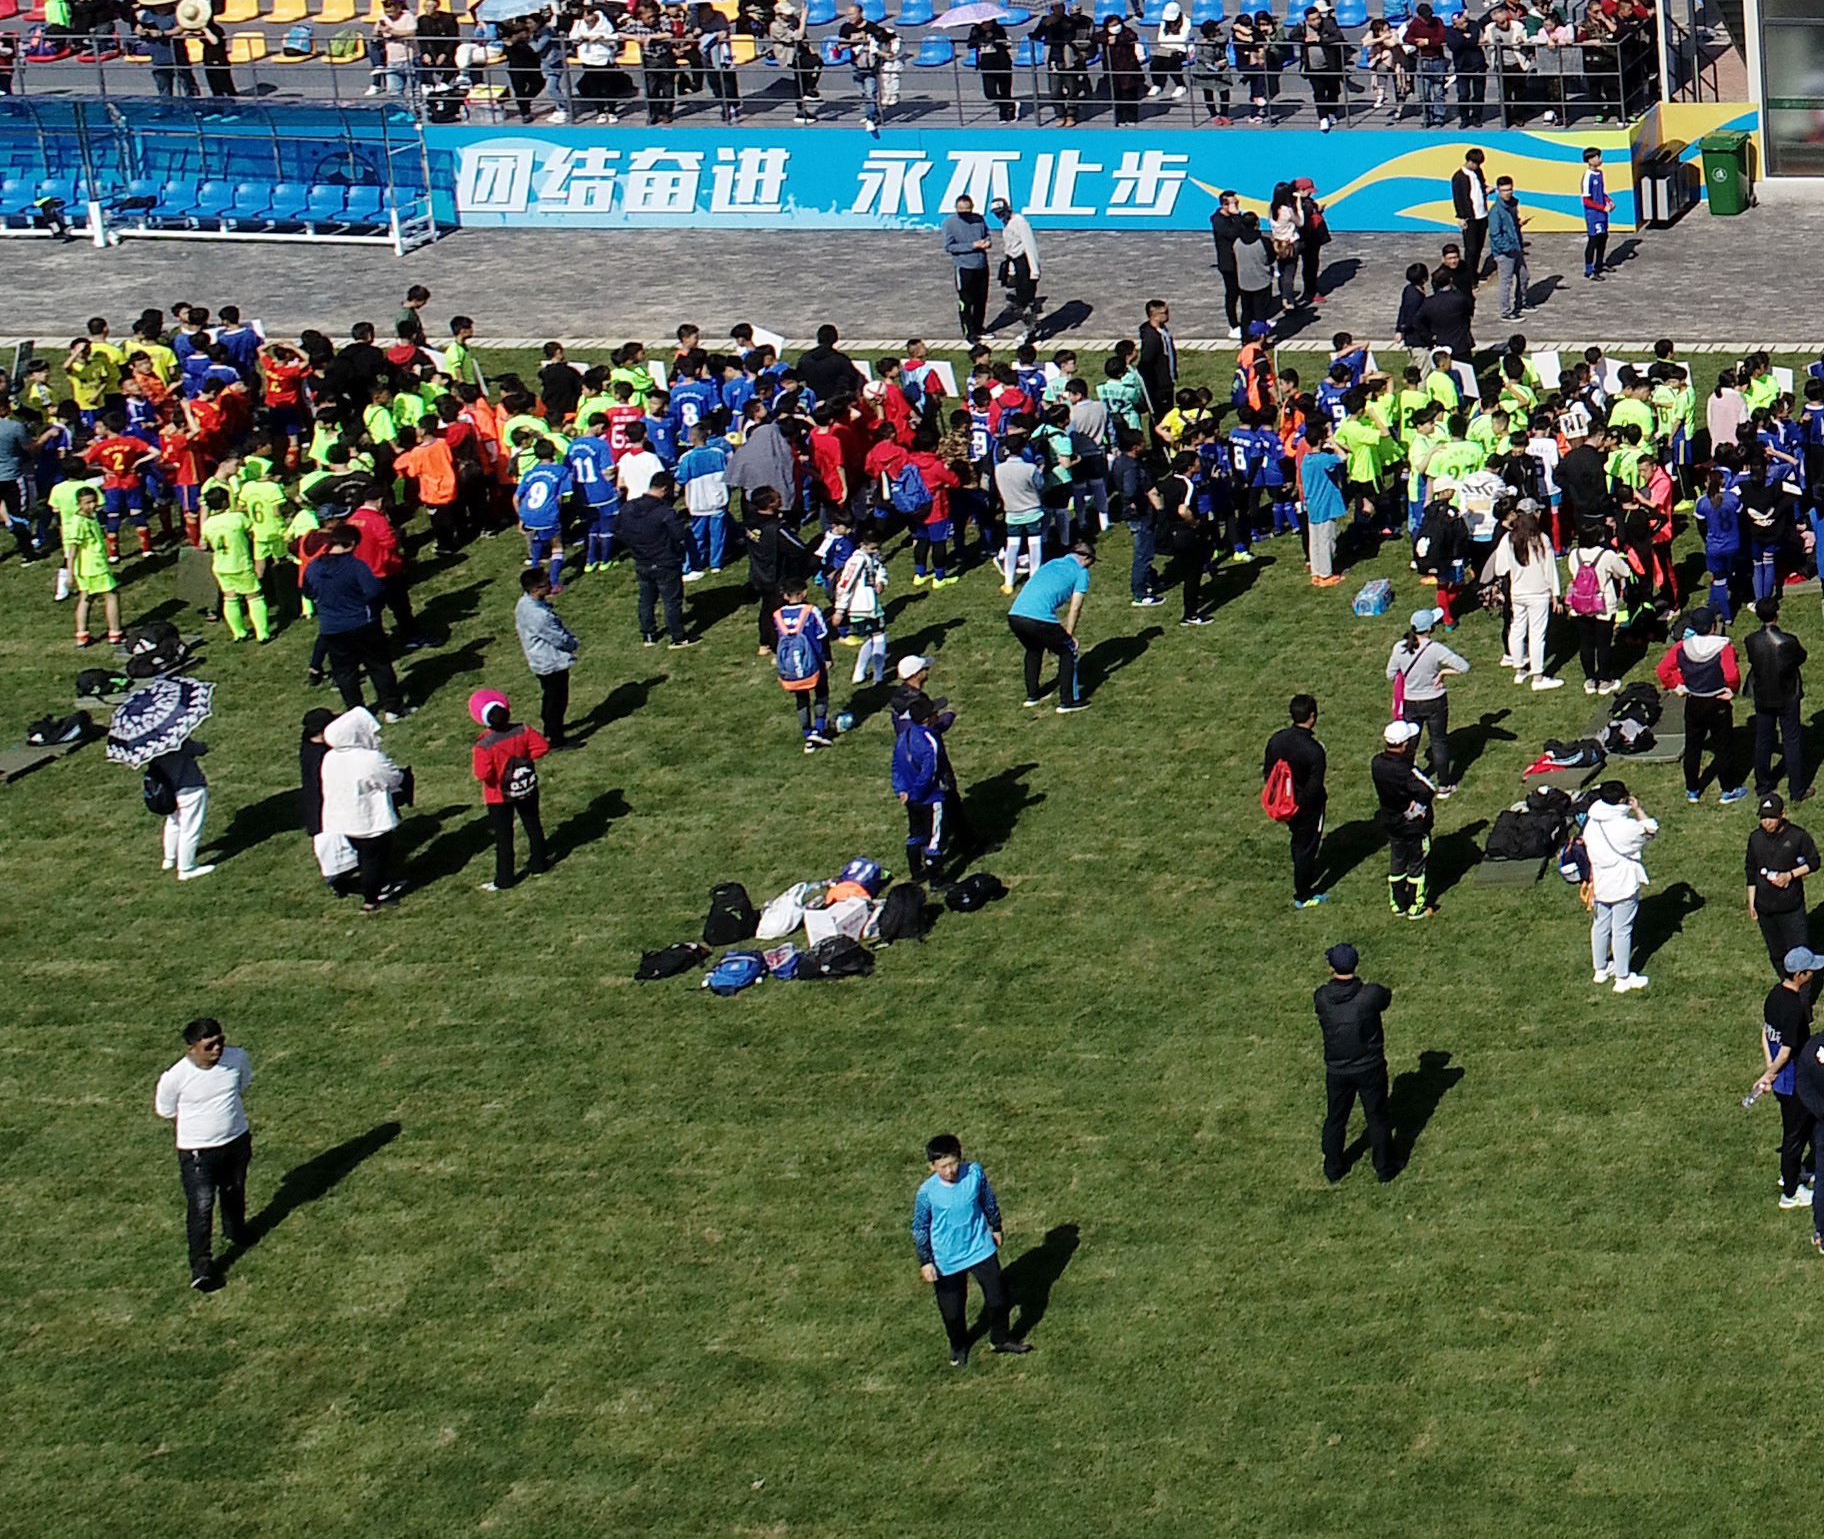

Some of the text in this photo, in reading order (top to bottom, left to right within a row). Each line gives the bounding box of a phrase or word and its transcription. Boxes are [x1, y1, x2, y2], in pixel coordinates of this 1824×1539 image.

[459, 148, 1190, 218] 团结奋进 永不止步
[112, 453, 126, 471] 2
[573, 456, 598, 483] 11
[528, 481, 548, 510] 9
[254, 500, 265, 524] 6
